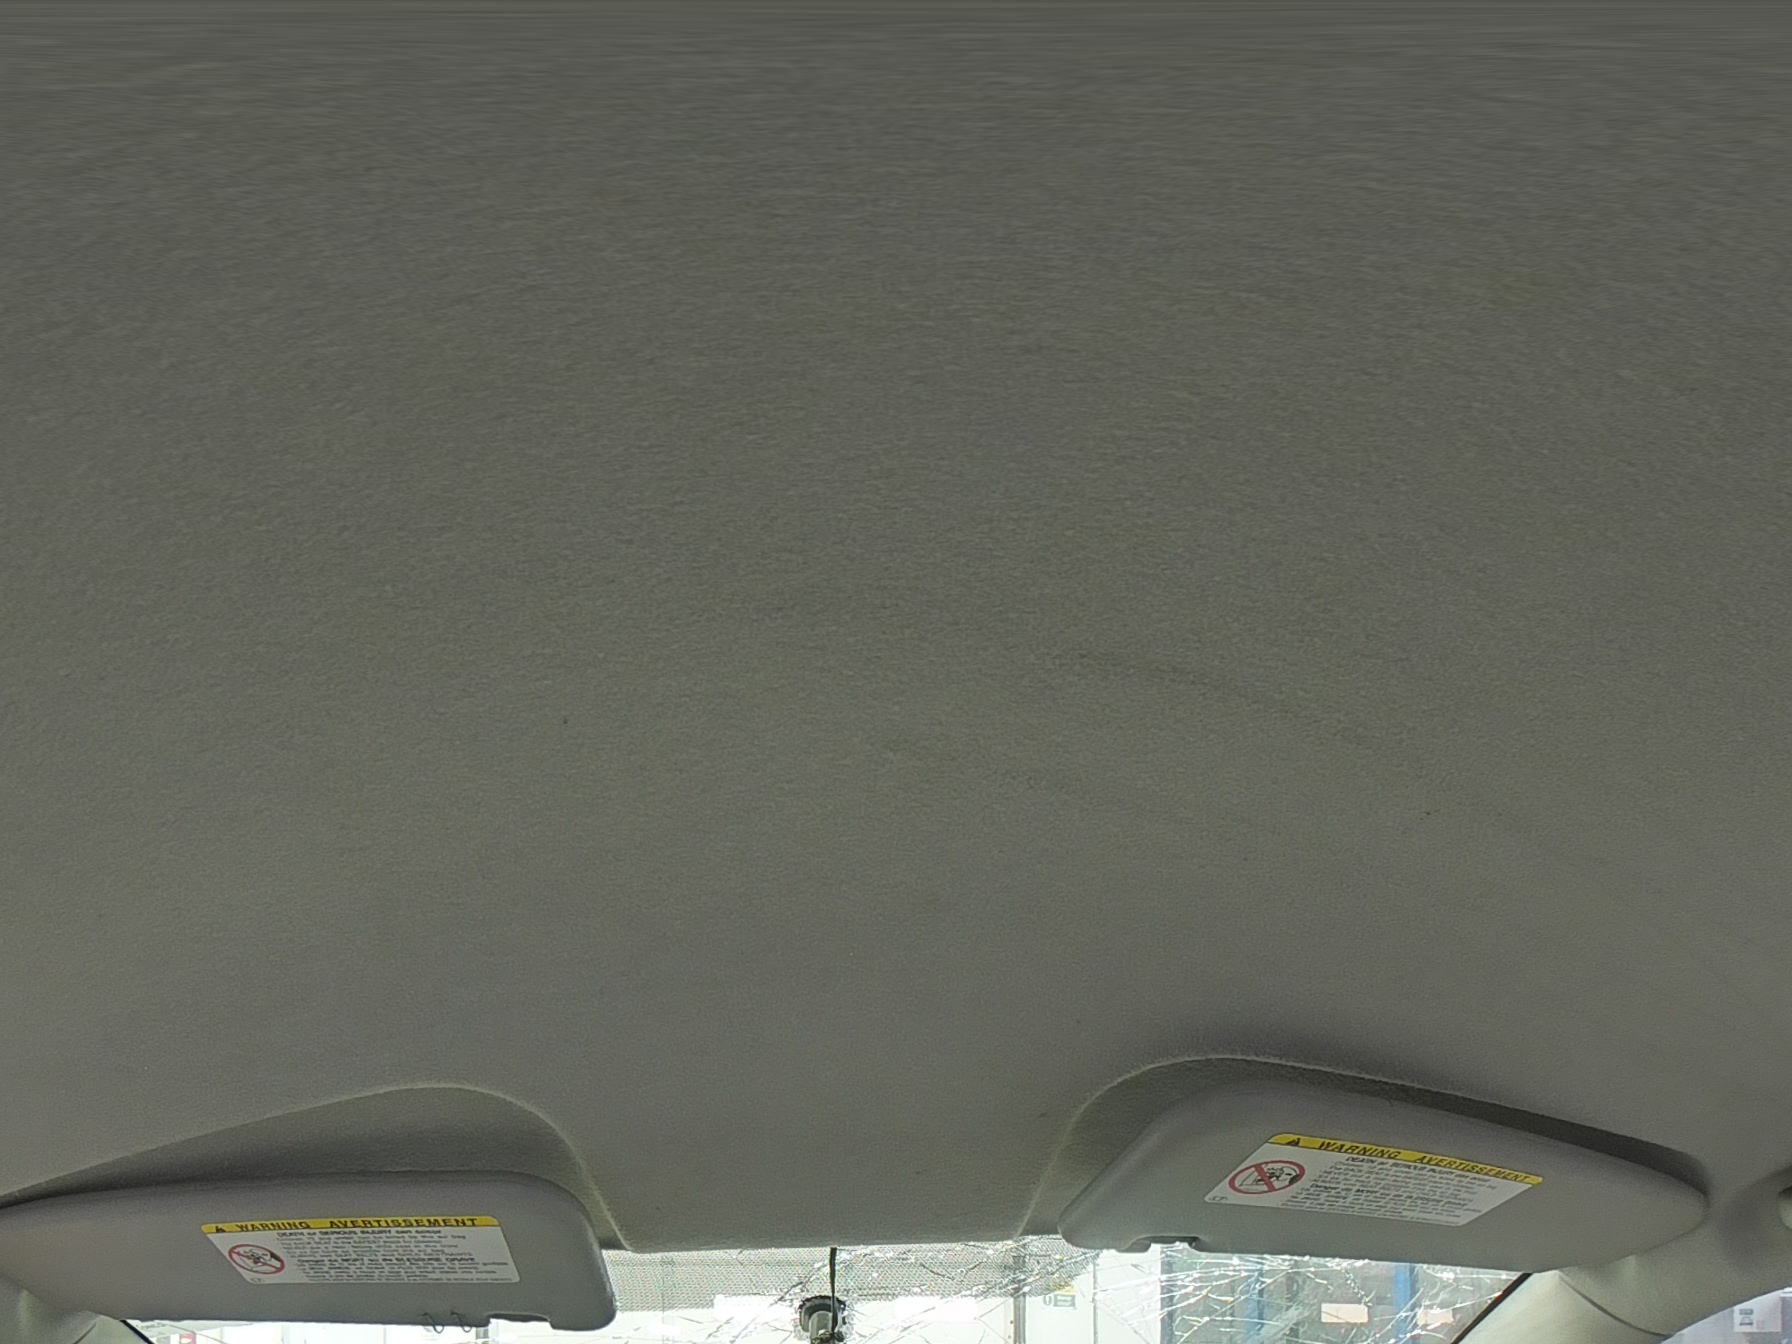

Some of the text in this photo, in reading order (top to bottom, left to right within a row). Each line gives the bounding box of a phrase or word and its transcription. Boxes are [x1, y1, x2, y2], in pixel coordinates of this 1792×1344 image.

[1318, 1140, 1401, 1160] WARNING
[1414, 1155, 1529, 1182] AVERTISSEMENT
[236, 1217, 478, 1232] WARNING AVERTISSEMENT
